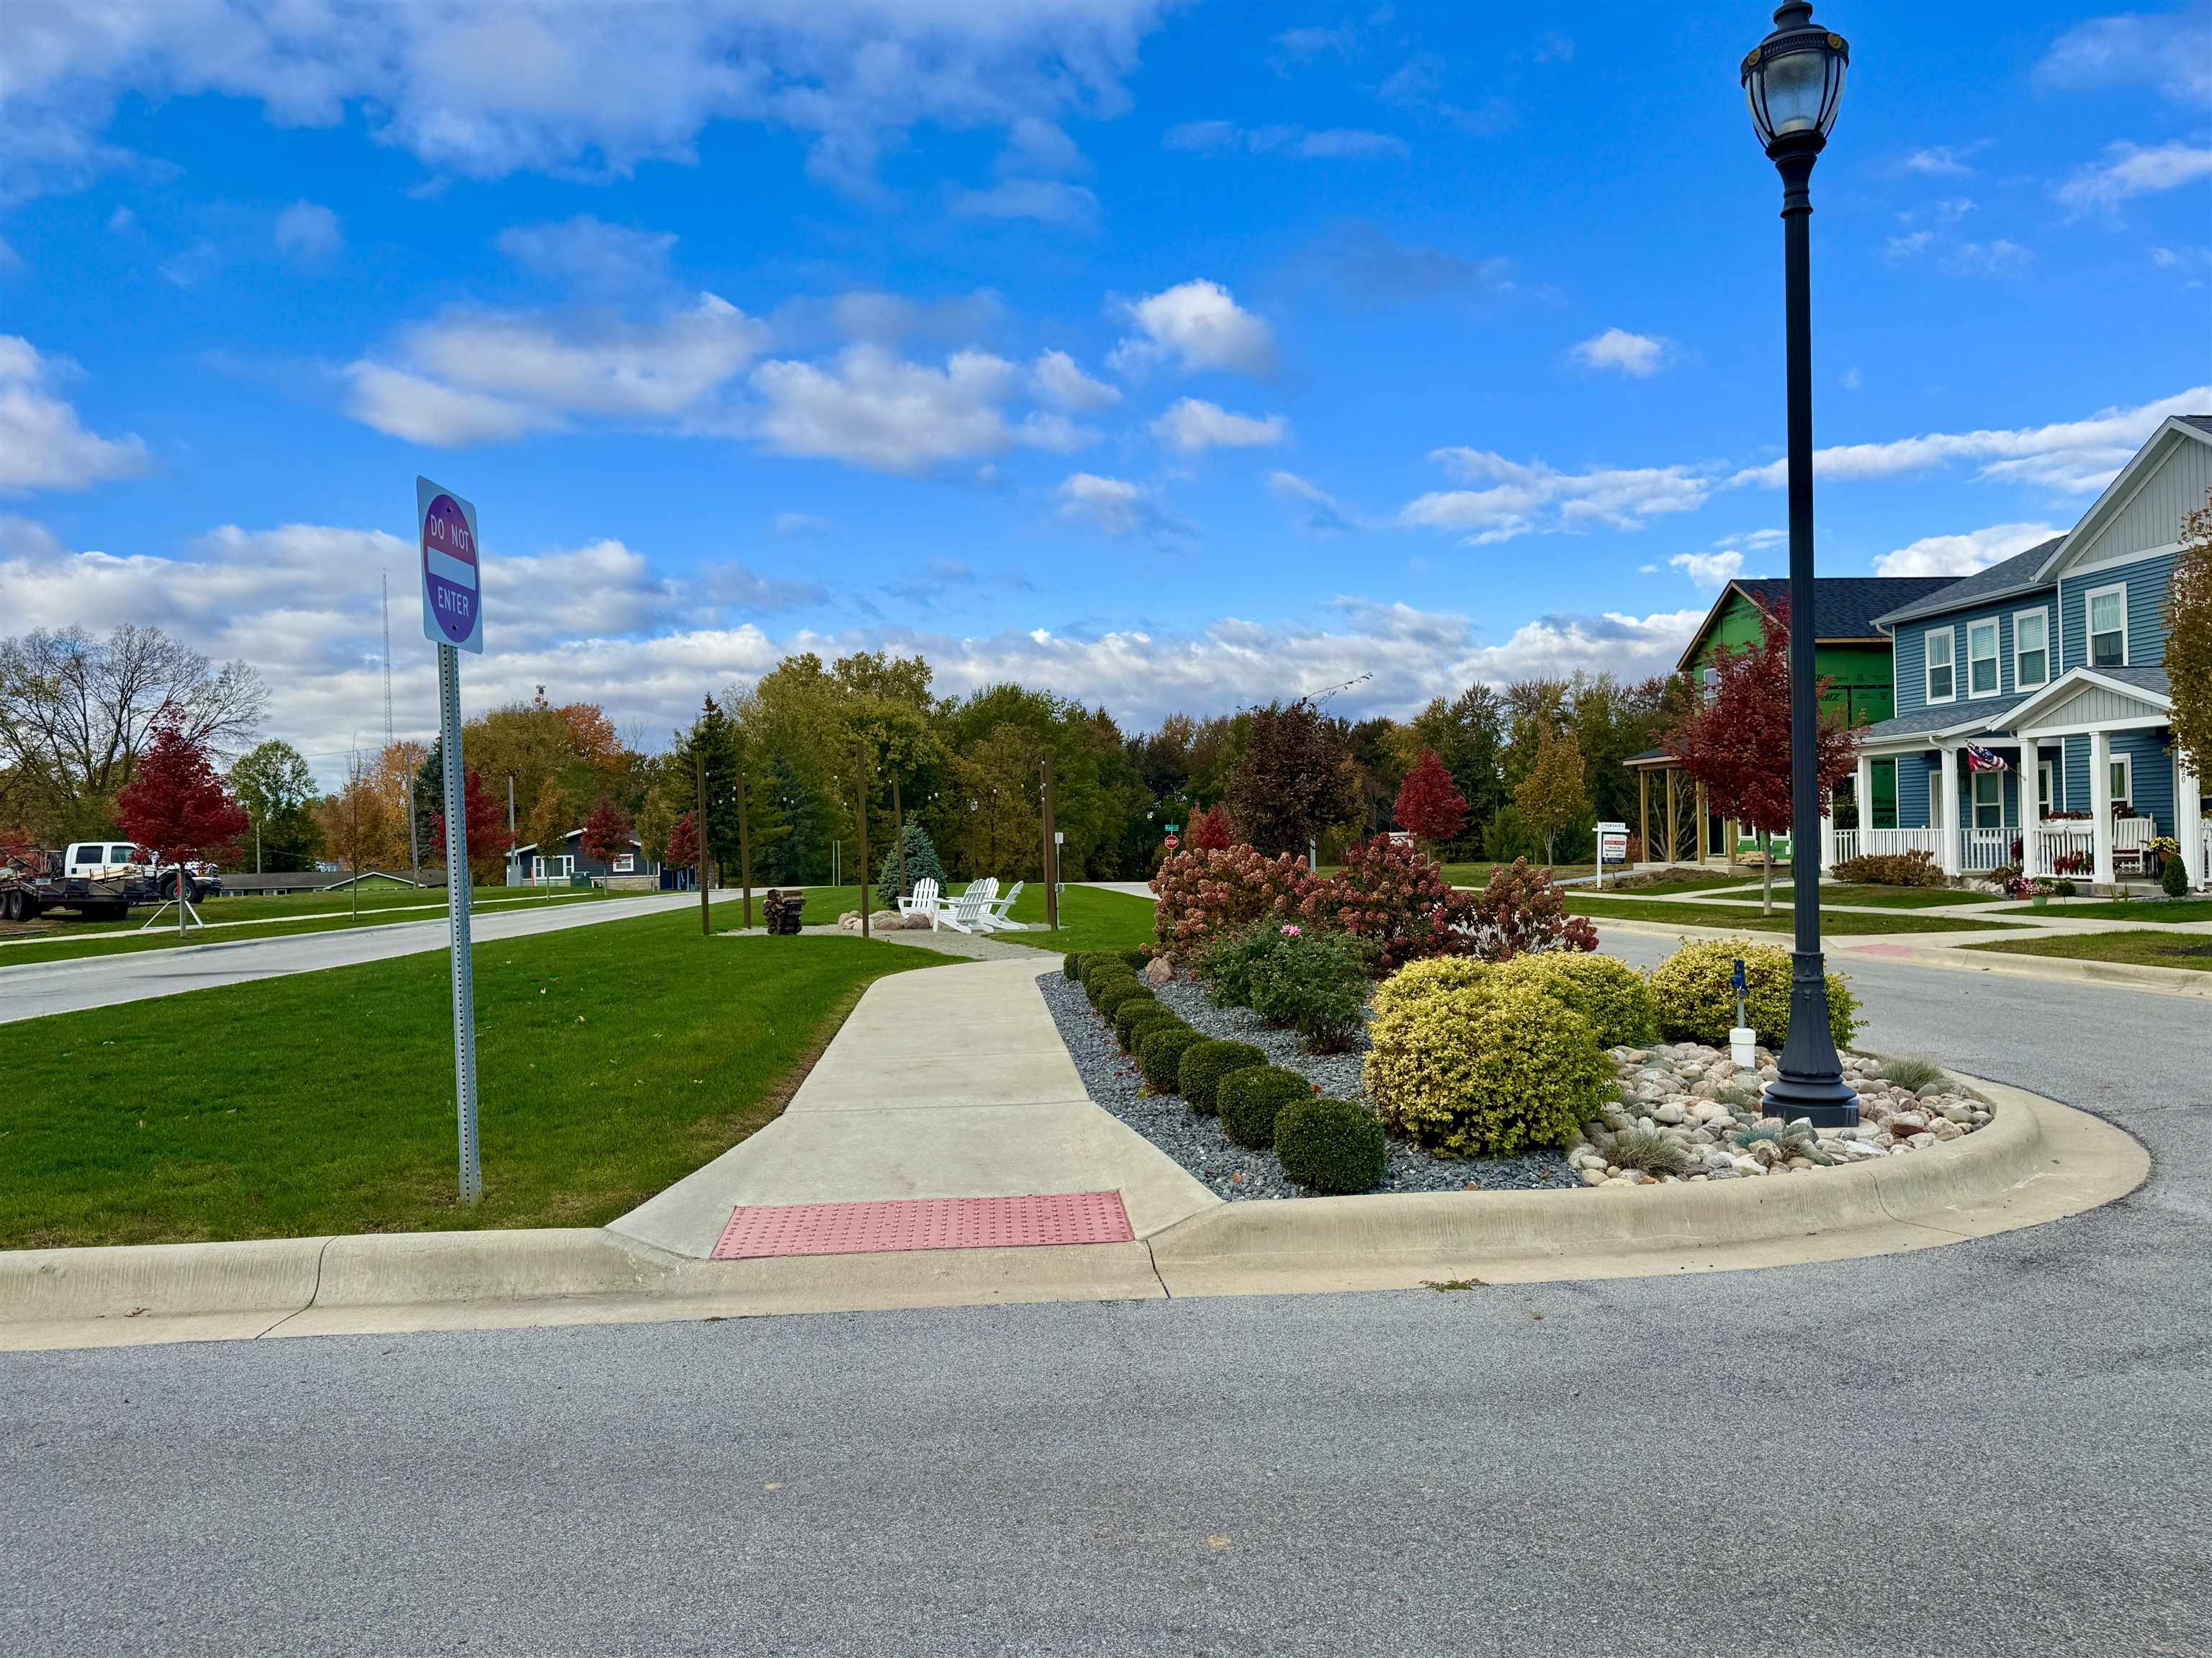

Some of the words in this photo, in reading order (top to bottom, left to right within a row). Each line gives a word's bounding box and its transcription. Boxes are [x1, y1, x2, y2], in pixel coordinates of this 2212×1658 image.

[431, 514, 444, 540] DO
[451, 524, 469, 551] NOT
[438, 586, 469, 617] ENTER
